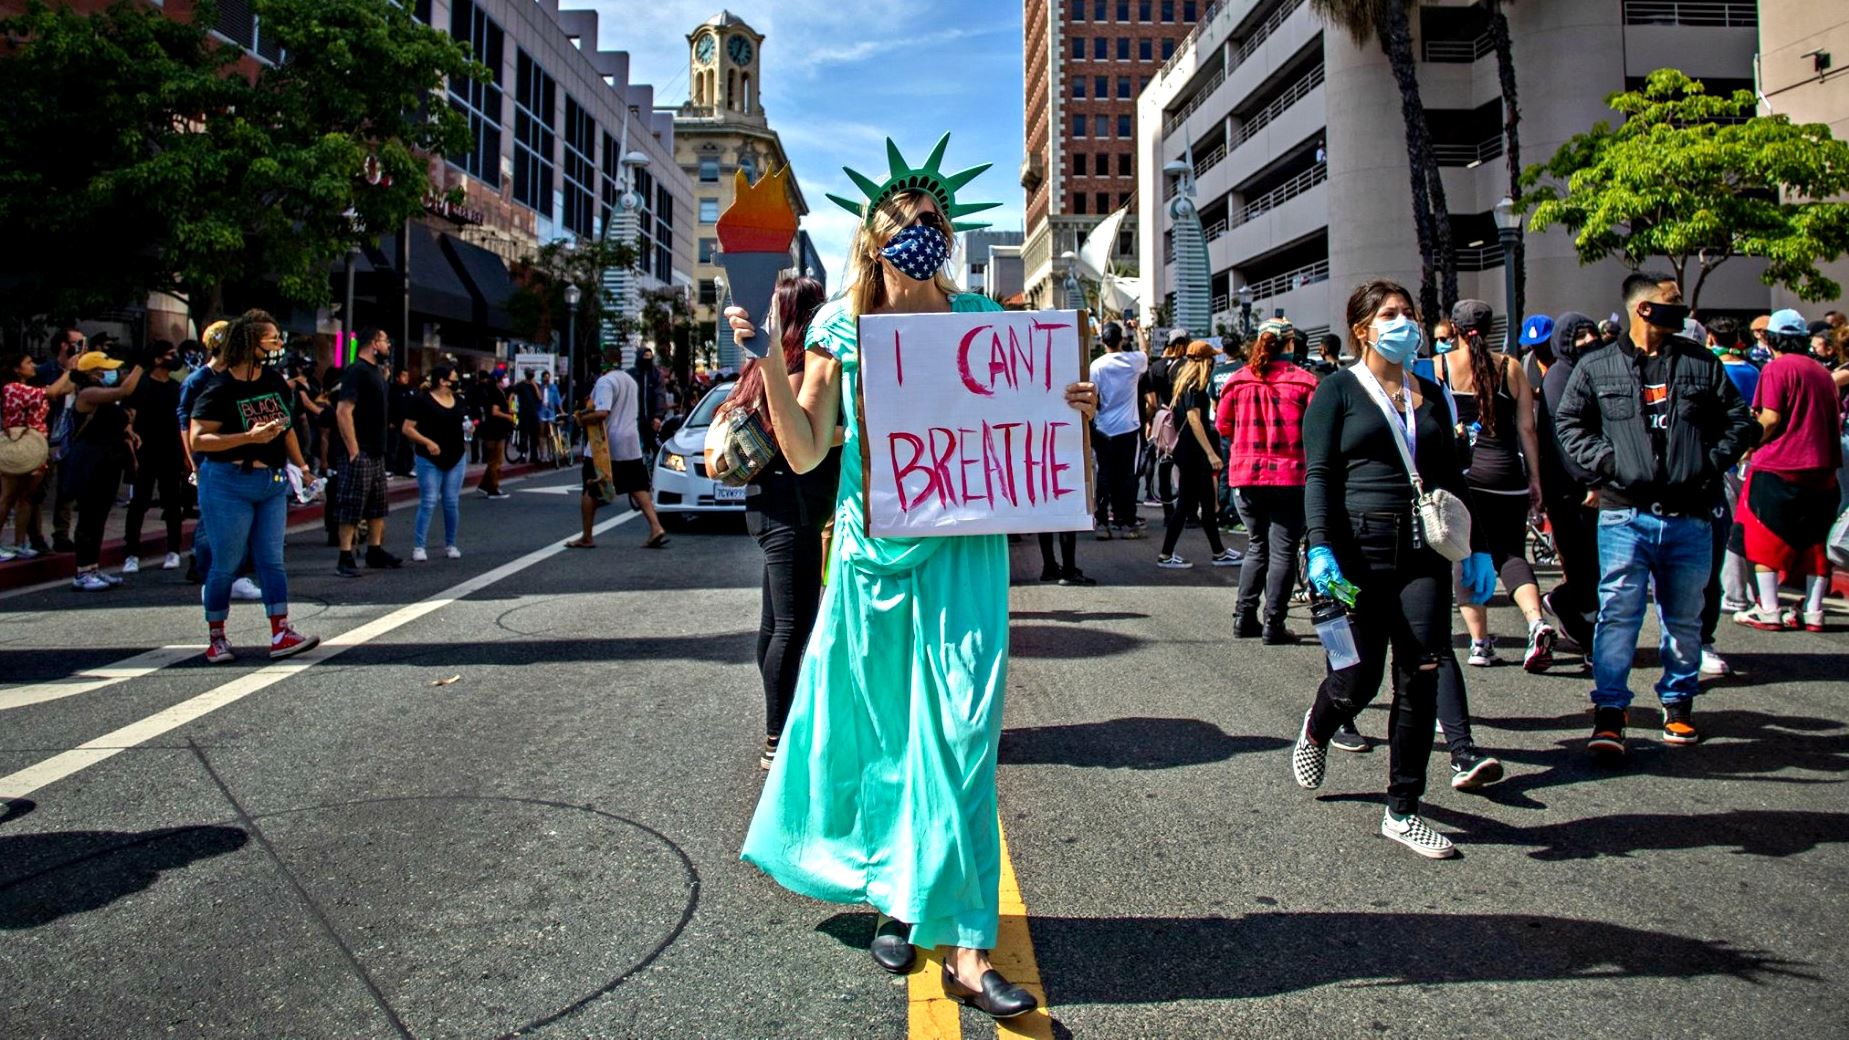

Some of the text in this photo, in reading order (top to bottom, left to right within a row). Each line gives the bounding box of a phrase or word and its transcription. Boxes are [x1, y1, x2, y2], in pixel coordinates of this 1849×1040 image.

[895, 329, 903, 387] I
[241, 397, 284, 417] BLACK
[887, 419, 1077, 513] BREATHE
